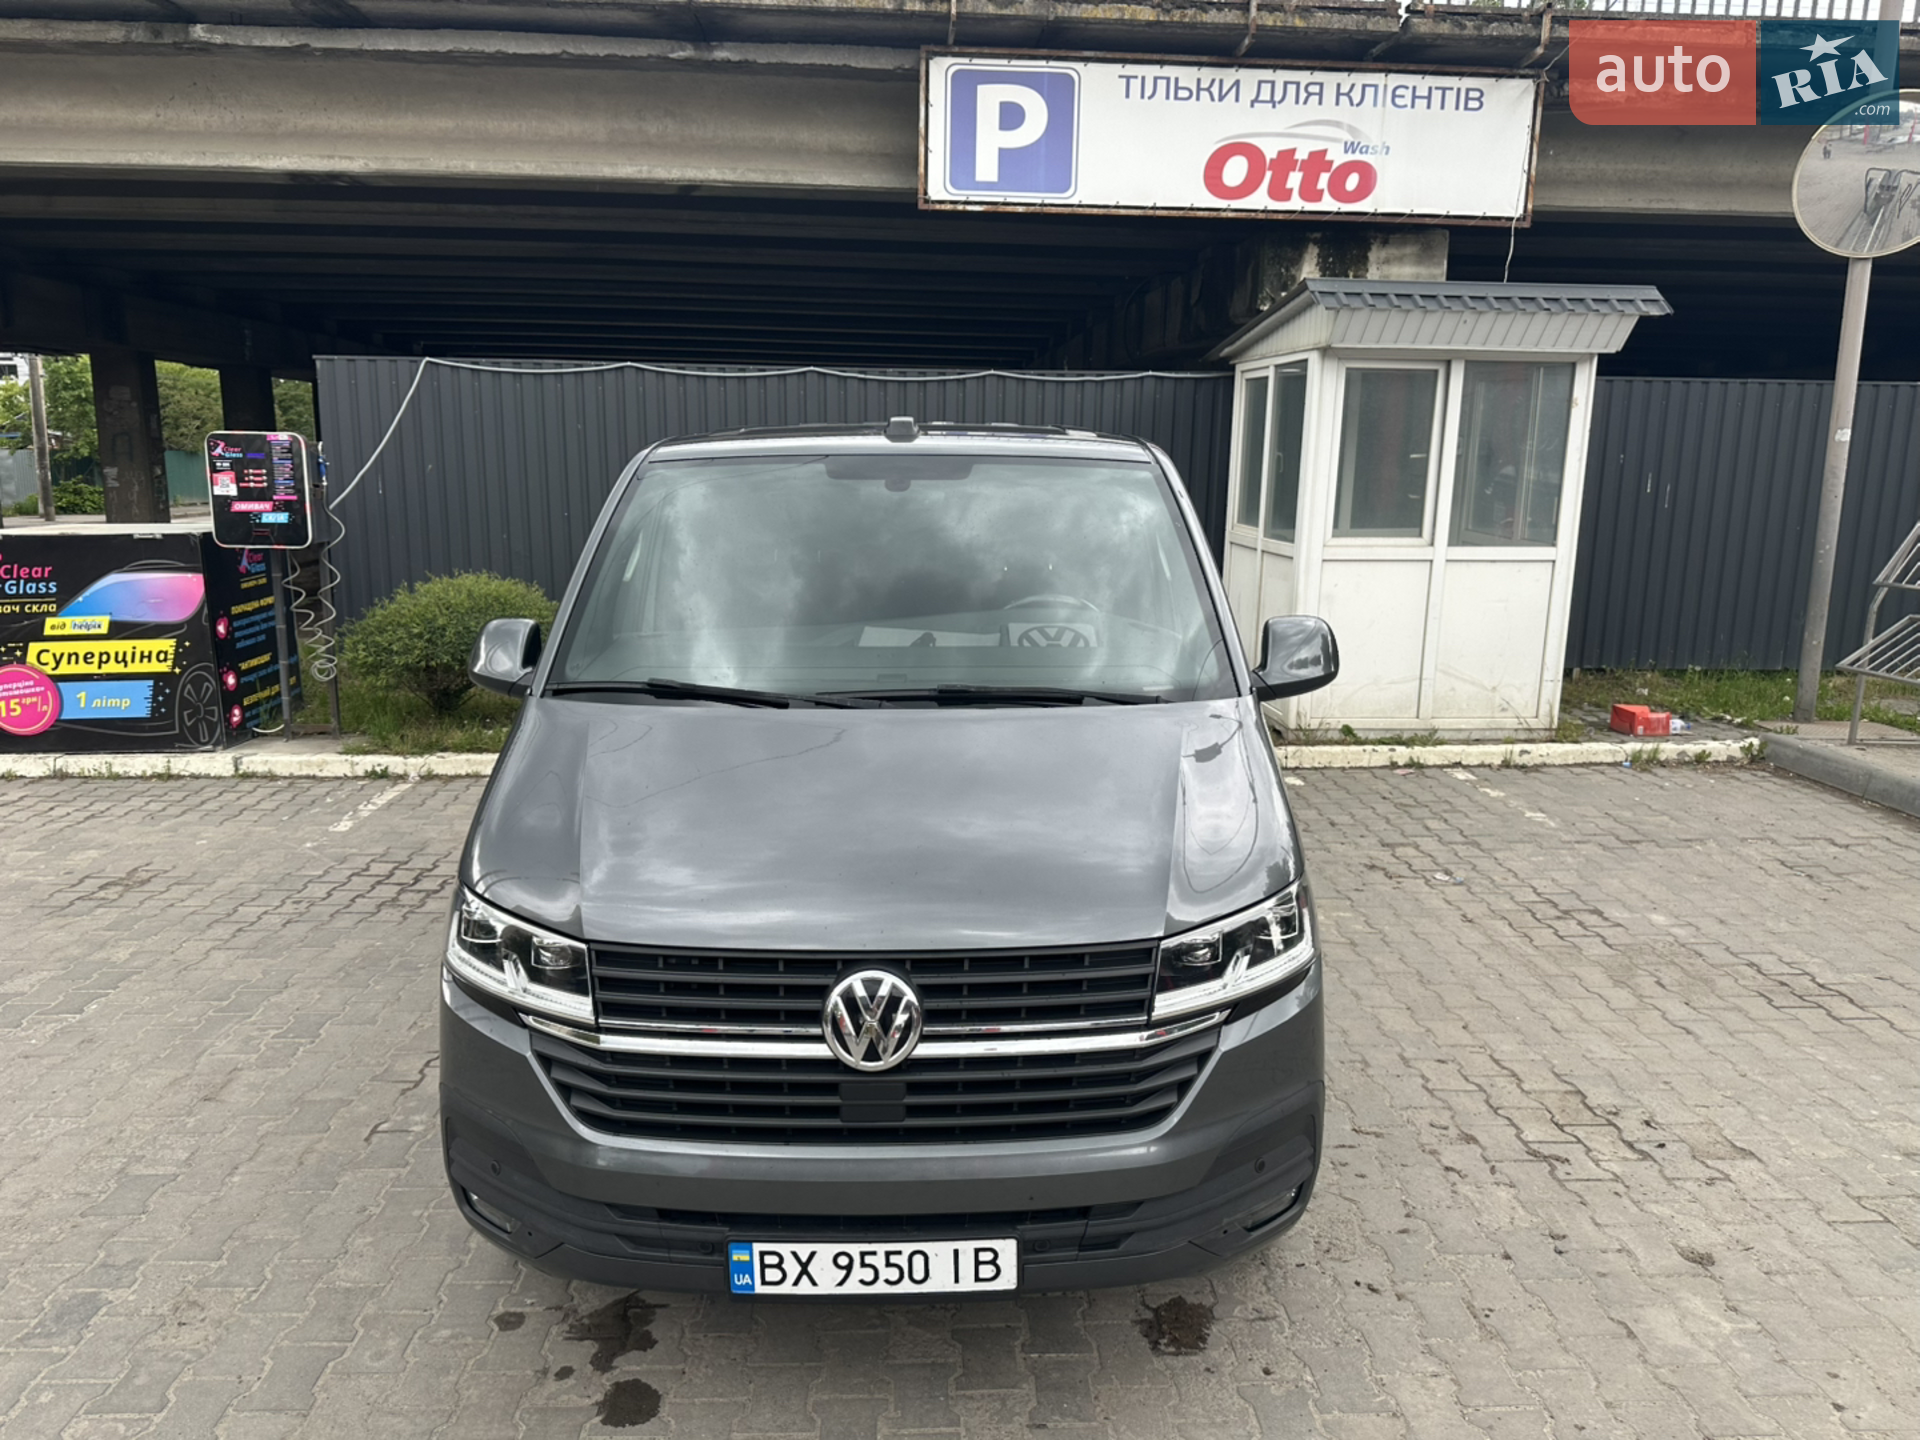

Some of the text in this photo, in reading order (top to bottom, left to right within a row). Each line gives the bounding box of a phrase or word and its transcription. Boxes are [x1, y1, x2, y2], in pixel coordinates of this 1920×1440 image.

[1118, 74, 1485, 111] ТІЛЬКИ ДЛЯ КЛІЄНТІВ
[975, 83, 1048, 183] P
[1343, 140, 1390, 156] Wash
[1203, 141, 1378, 204] Otto
[234, 502, 270, 510] ОМИВАЧ
[0, 563, 52, 579] Clear
[4, 579, 57, 595] Glass
[24, 603, 57, 613] скла
[50, 621, 67, 631] від
[36, 646, 169, 670] Суперціна
[76, 691, 131, 710] 1 літр
[758, 1247, 1001, 1287] BX 9550 IB
[734, 1273, 752, 1285] UA
